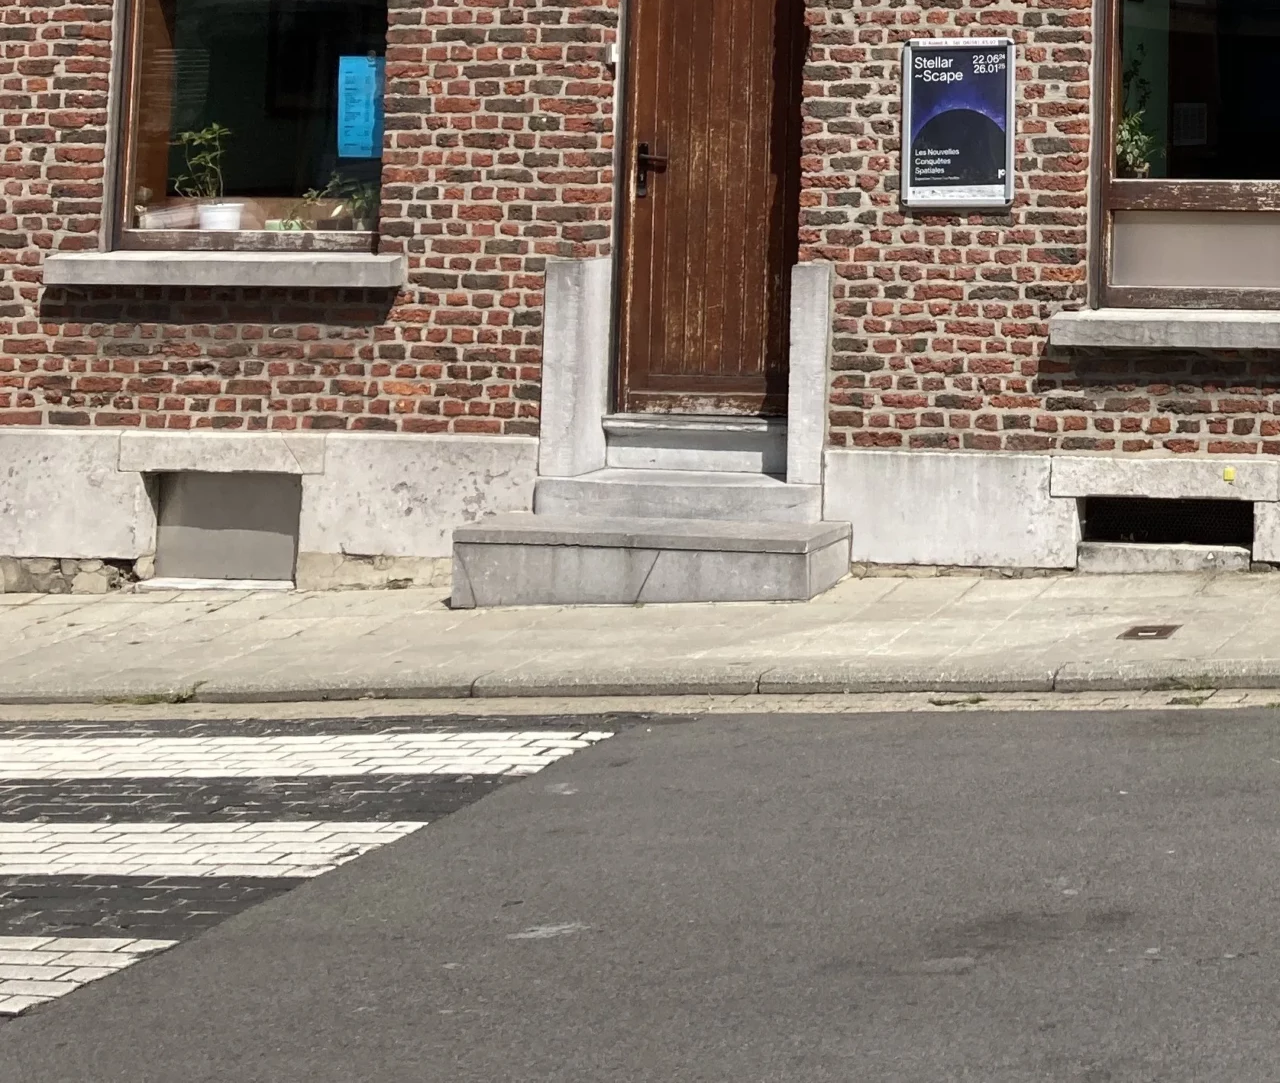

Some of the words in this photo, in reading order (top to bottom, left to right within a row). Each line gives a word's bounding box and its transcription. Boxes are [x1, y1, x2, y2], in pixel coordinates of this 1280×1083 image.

[914, 56, 954, 70] Stellar
[928, 148, 960, 156] Nouvelles
[914, 167, 945, 175] Spatiales
